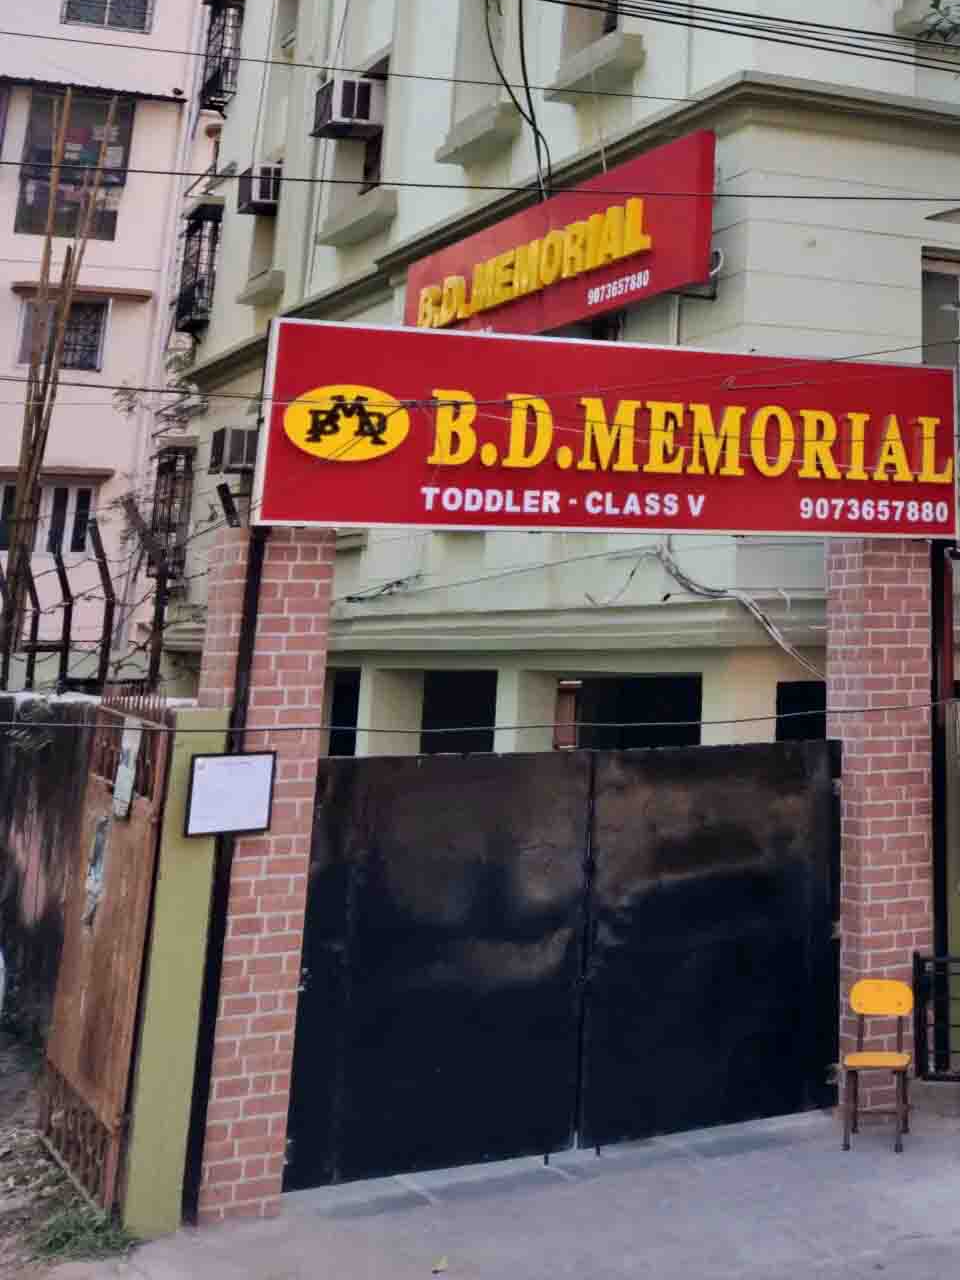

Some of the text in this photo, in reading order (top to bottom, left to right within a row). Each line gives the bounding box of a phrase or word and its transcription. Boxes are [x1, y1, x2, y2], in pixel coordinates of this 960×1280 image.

[587, 269, 650, 305] 9073657880
[420, 486, 561, 513] TODDLER
[584, 491, 679, 516] CLASS
[687, 494, 705, 516] V
[800, 496, 949, 522] 9073657880
